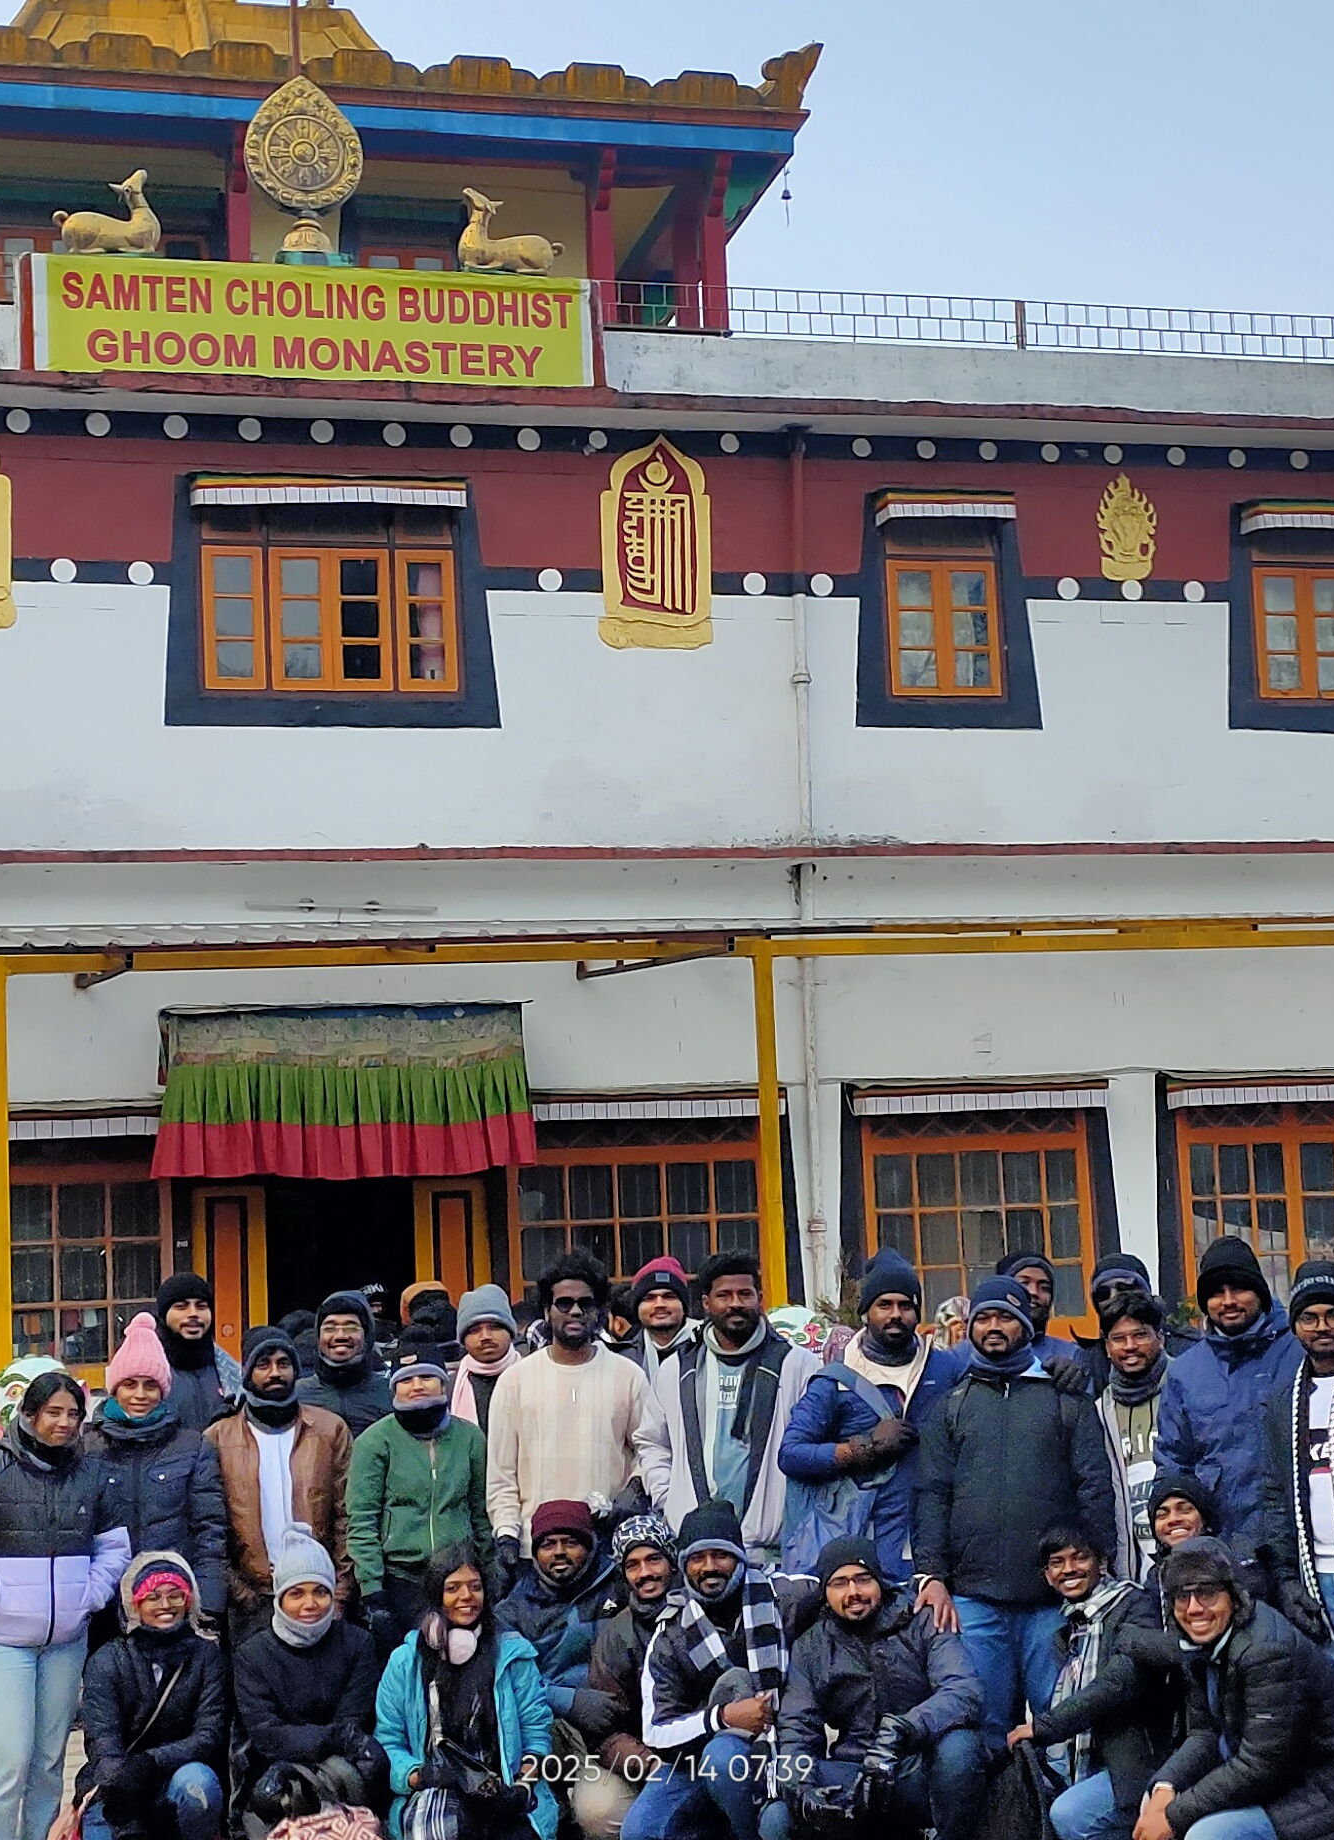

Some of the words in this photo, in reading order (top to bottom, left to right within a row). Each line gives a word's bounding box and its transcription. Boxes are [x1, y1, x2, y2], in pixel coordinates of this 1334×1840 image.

[61, 270, 212, 315] SAMTEN
[229, 277, 387, 322] CHOLING
[398, 285, 574, 330] BUDDHIST
[86, 328, 257, 369] GHOOM
[272, 336, 544, 378] MONASTERY
